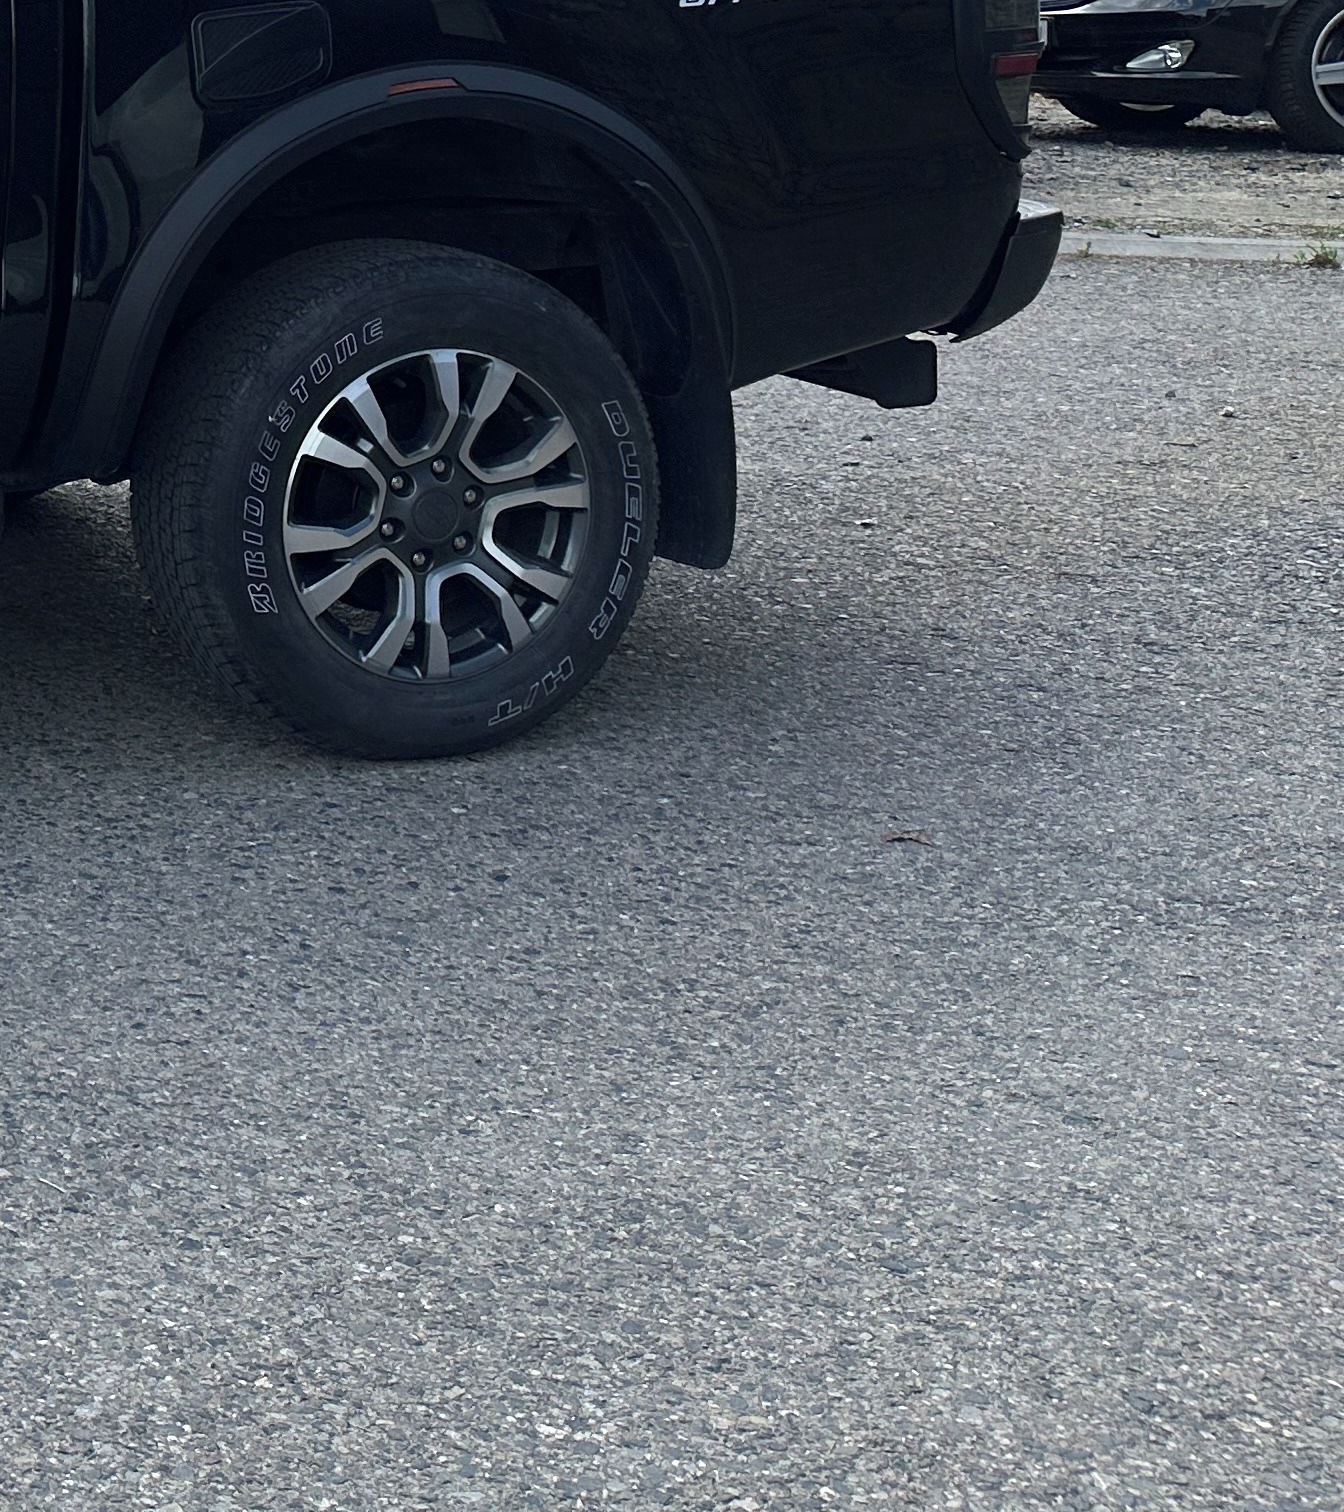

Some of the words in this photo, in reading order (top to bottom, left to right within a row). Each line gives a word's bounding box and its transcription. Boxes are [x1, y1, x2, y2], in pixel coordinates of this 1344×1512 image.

[231, 318, 384, 615] BRIDGESTONE
[589, 399, 642, 640] DUELER
[487, 655, 575, 727] H/T
